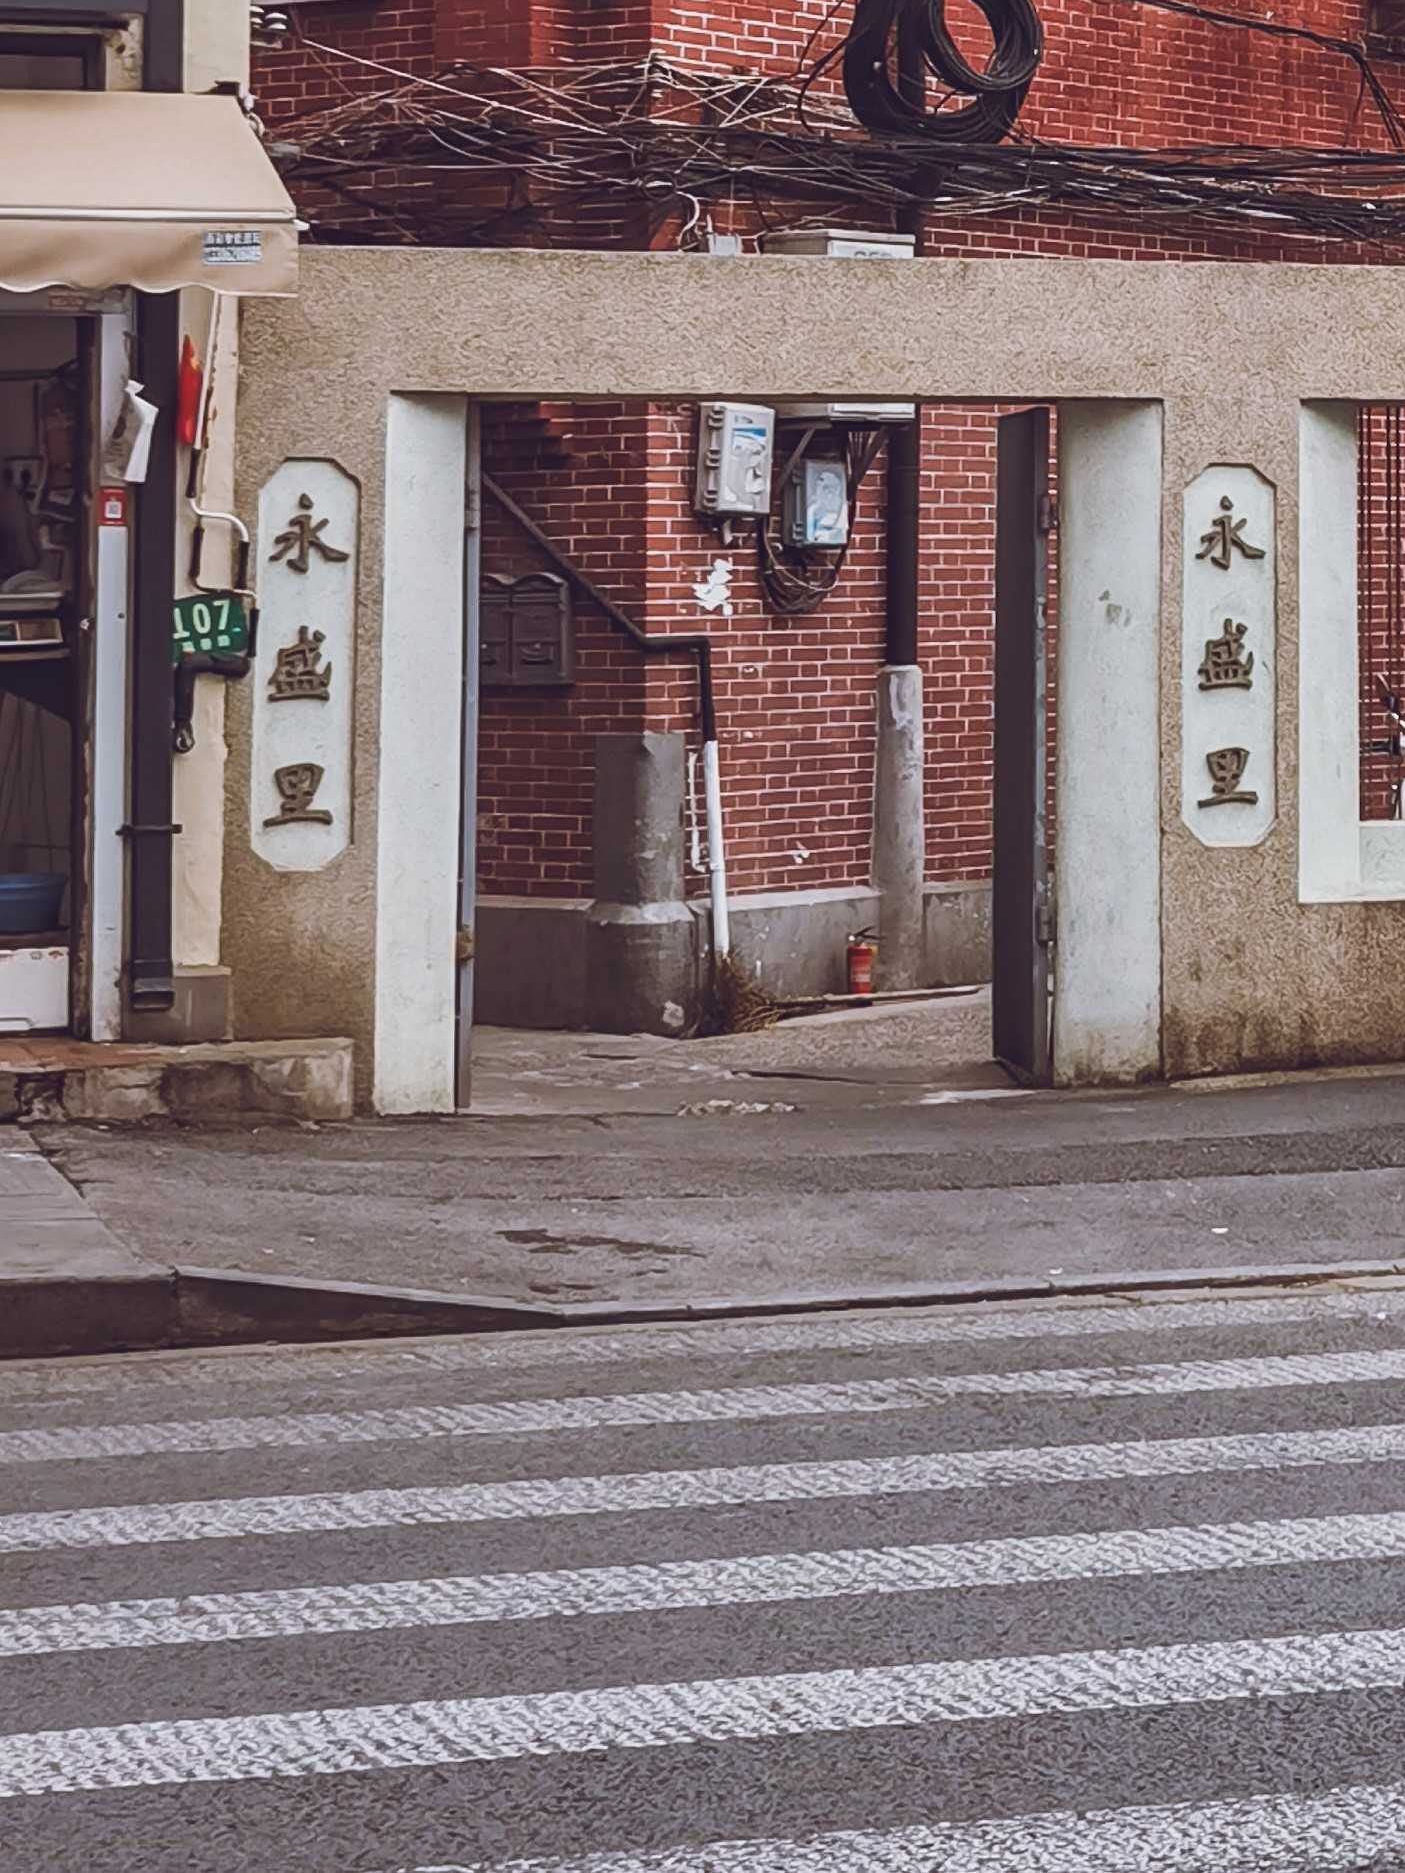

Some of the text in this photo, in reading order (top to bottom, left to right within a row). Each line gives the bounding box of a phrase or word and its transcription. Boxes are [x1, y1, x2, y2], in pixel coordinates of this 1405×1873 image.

[173, 599, 230, 639] 107
[263, 493, 350, 827] 永盛里
[1195, 495, 1266, 808] 永盛里
